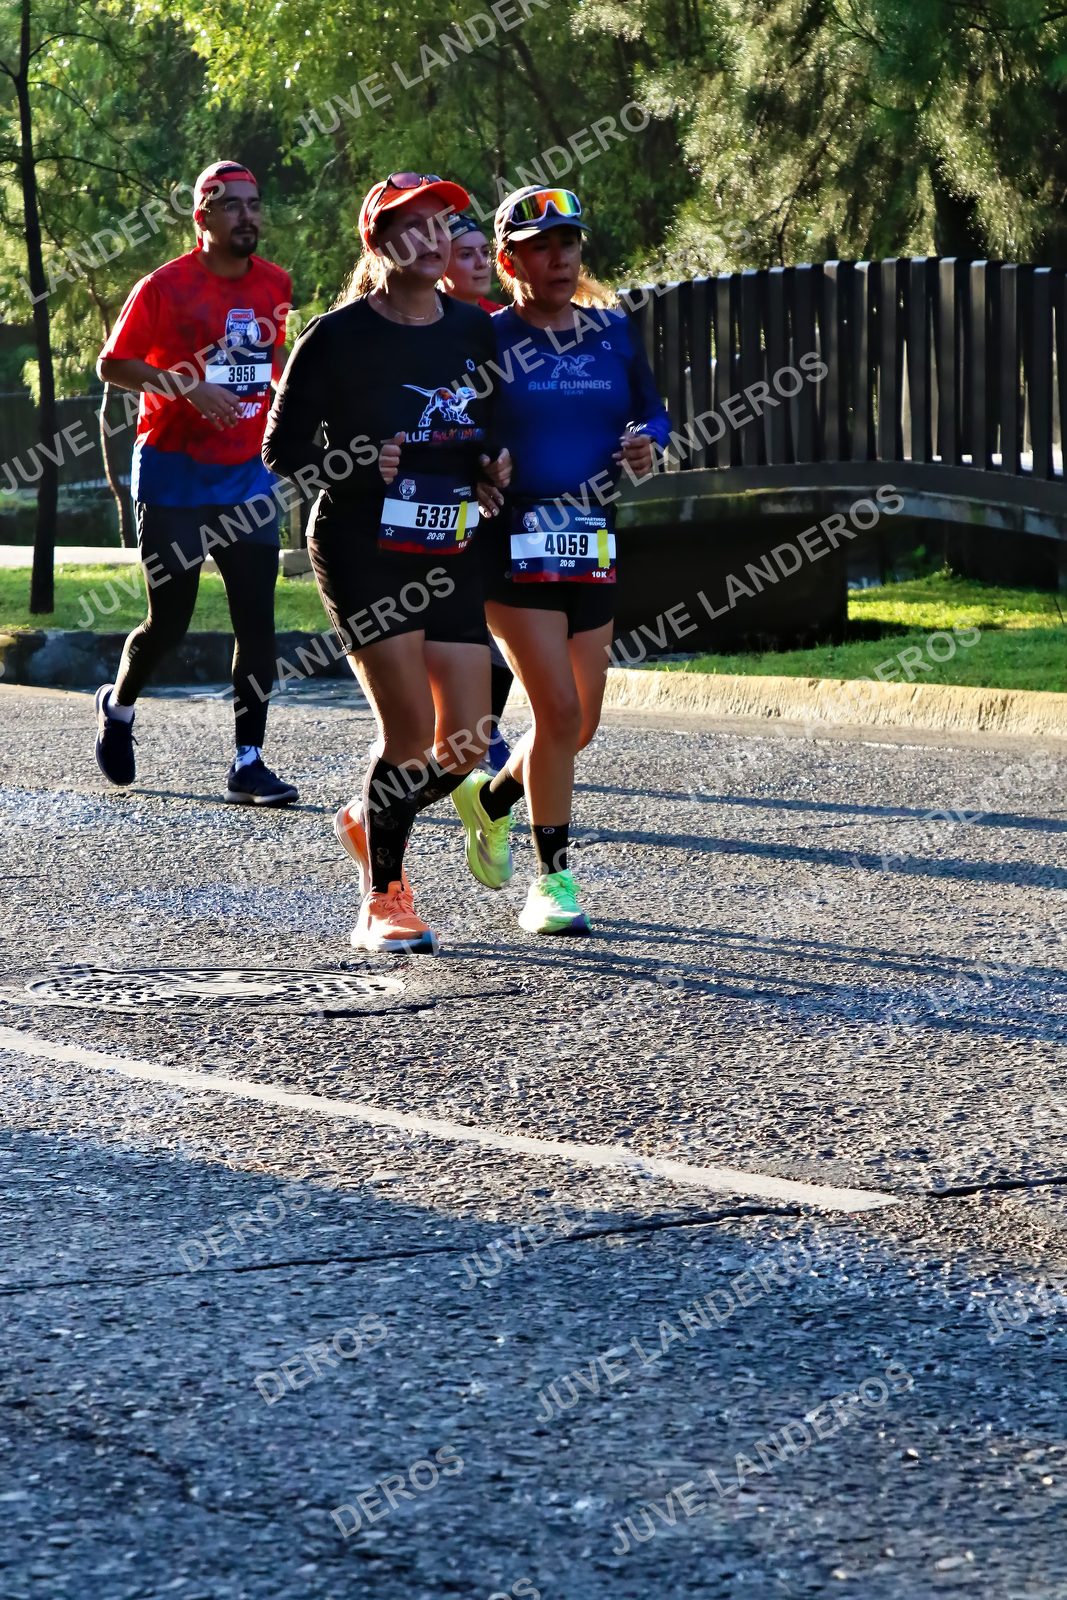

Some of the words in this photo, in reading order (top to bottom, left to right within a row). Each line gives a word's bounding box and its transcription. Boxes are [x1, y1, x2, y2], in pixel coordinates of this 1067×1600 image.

[228, 366, 256, 383] 3958
[528, 380, 559, 391] BLUE
[559, 380, 612, 390] RUNNERS
[402, 429, 432, 443] LUE
[415, 505, 460, 528] 5337
[544, 534, 588, 556] 4059
